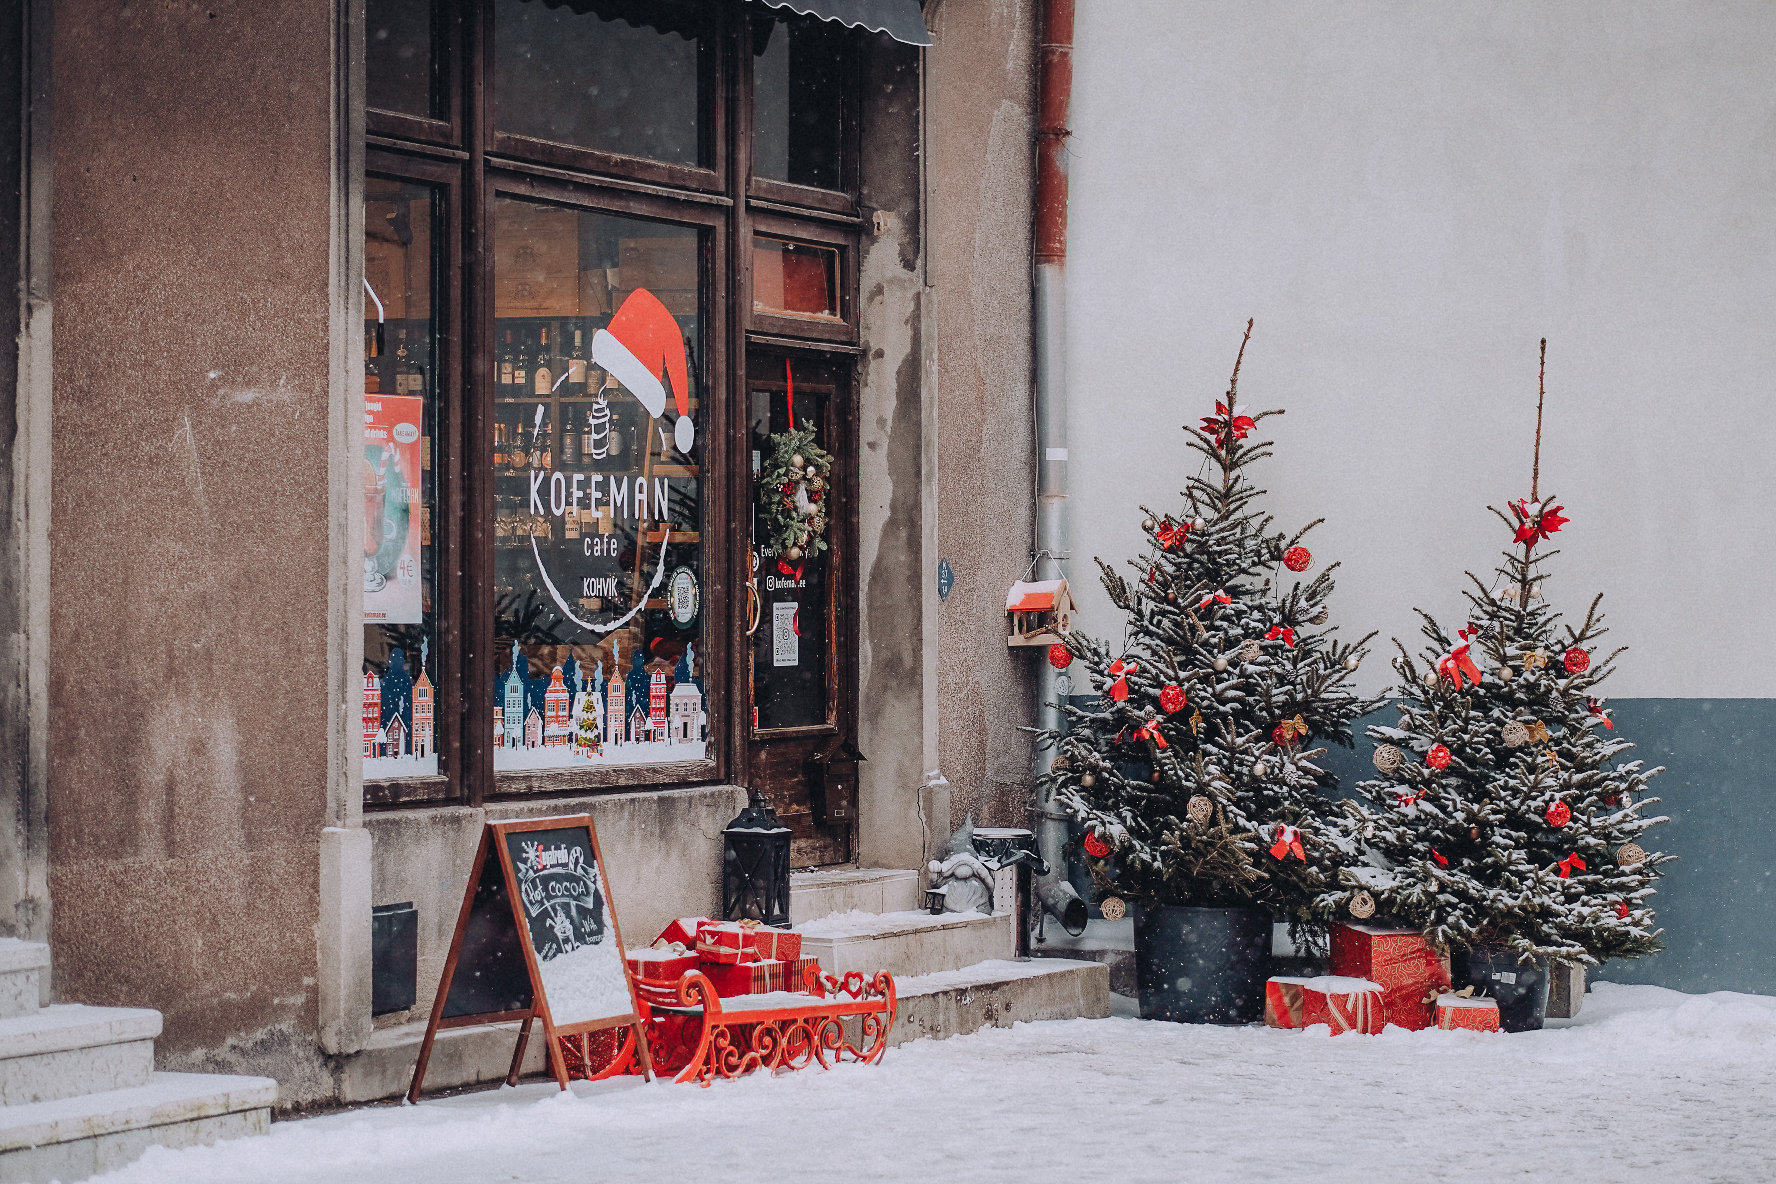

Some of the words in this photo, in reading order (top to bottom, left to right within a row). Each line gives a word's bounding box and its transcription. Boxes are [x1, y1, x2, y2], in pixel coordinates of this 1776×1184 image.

[530, 470, 669, 520] KOFEMAN
[584, 532, 618, 557] cafe
[583, 577, 618, 597] KOHVIK
[526, 878, 546, 903] Hot
